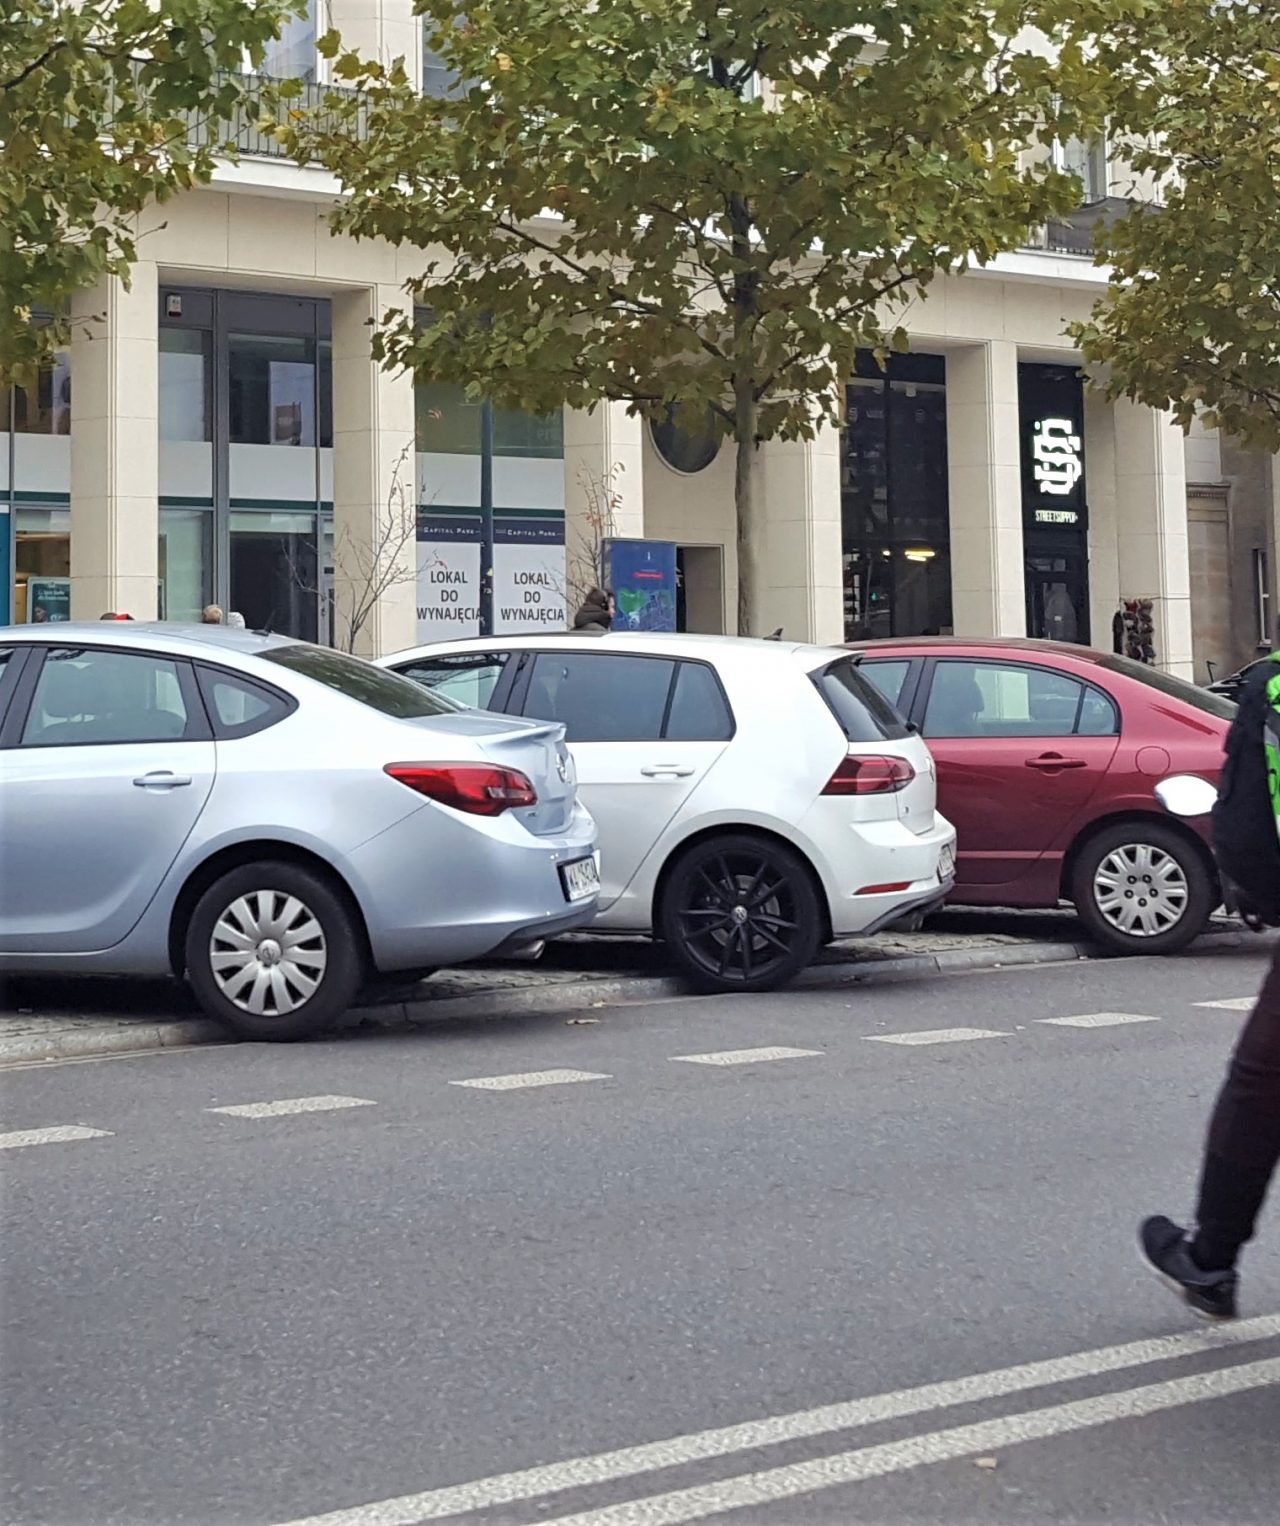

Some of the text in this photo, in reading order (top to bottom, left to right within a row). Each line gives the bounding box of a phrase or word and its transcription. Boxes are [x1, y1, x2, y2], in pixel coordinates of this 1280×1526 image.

[423, 526, 475, 535] CAPITAL PARK
[507, 529, 556, 538] CAPITAL PARK
[430, 570, 468, 584] LOKAL
[514, 572, 550, 585] LOKAL
[440, 589, 459, 602] DO
[524, 591, 541, 603] DO
[417, 607, 481, 624] WYNAJĘCIA
[501, 608, 565, 624] WYNAJĘCIA
